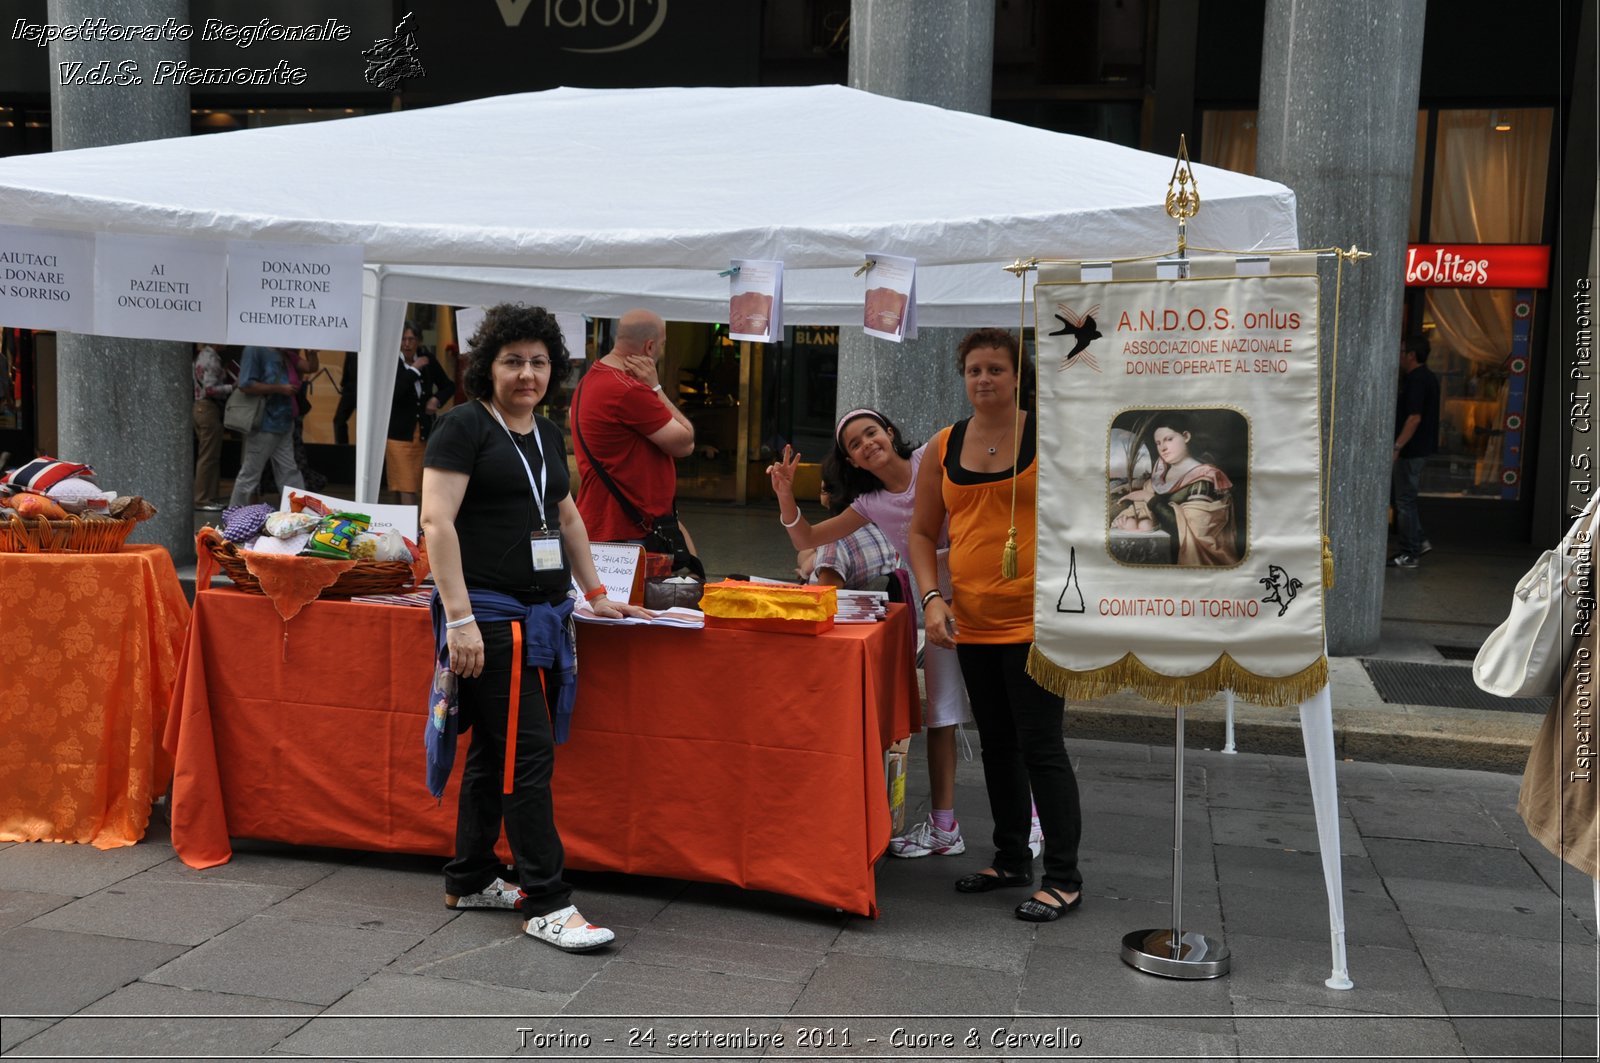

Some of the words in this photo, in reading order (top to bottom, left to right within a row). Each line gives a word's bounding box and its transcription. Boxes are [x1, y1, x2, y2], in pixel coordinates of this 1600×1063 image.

[0, 251, 57, 267] AIUTACI
[1406, 248, 1488, 284] lolitas
[5, 268, 65, 285] DONARE
[151, 265, 165, 276] AI
[262, 261, 331, 275] DONANDO
[10, 285, 71, 302] SORRISO
[130, 279, 190, 294] PAZIENTI
[261, 278, 331, 293] POLTRONE
[117, 296, 202, 313] ONCOLOGICI
[271, 296, 295, 308] PER
[299, 297, 317, 310] LA
[239, 311, 349, 329] CHEMIOTERAPIA
[1117, 307, 1235, 331] A.N.D.O.S.
[1243, 308, 1301, 330] onlus
[796, 331, 840, 346] BLAN
[1123, 340, 1218, 355] ASSOCIAZIONE
[1221, 338, 1292, 354] NAZIONALE
[1126, 360, 1170, 375] DONNE
[1172, 359, 1232, 375] OPERATE
[1234, 359, 1251, 373] AL
[1253, 358, 1288, 374] SENO
[1098, 598, 1175, 617] COMITATO
[1180, 600, 1195, 617] DI
[1200, 599, 1259, 617] TORINO
